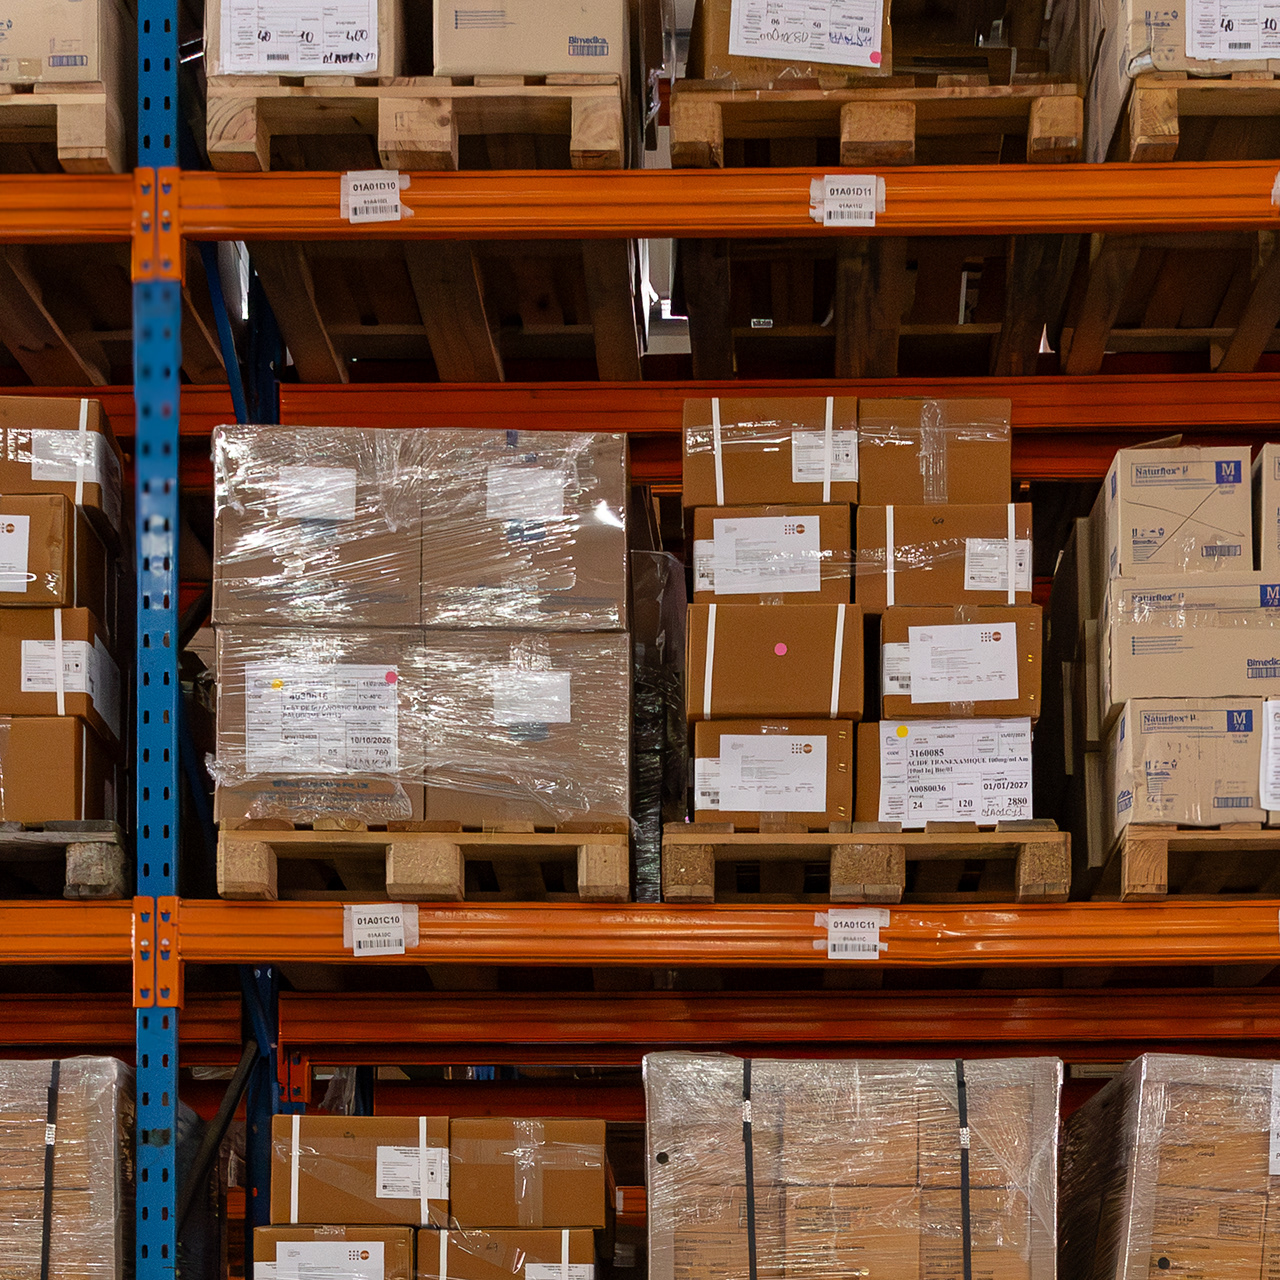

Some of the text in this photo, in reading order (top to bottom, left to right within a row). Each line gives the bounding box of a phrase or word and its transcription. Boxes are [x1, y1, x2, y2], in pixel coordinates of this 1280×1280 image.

[1262, 19, 1276, 30] 10
[353, 182, 396, 191] 01A01D10
[829, 187, 872, 196] 01A01D11
[1222, 463, 1234, 475] M
[1266, 586, 1280, 599] M
[1233, 712, 1246, 724] M
[349, 736, 392, 745] 10/10/2026
[909, 748, 944, 758] 3160085
[908, 784, 946, 793] A0080036
[983, 781, 1028, 791] 01/01/2027
[1007, 797, 1027, 807] 2880
[357, 917, 400, 925] 01A01C10
[833, 921, 875, 929] 01A01C11
